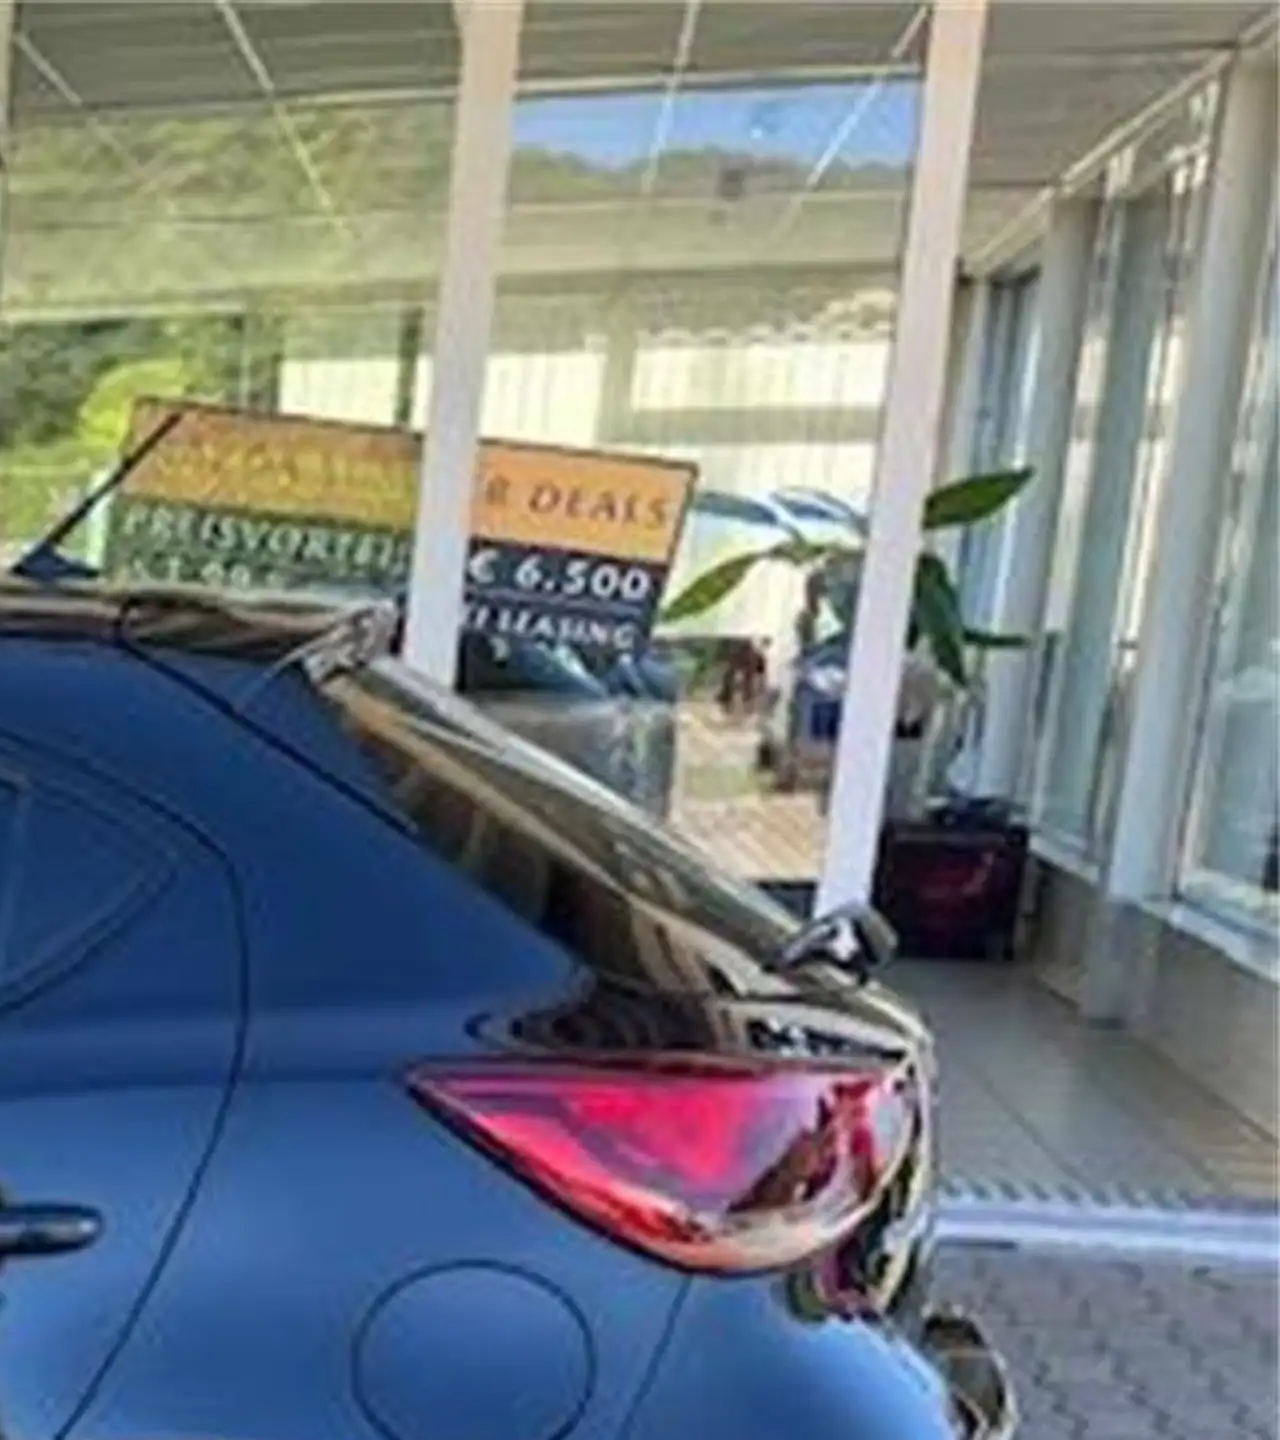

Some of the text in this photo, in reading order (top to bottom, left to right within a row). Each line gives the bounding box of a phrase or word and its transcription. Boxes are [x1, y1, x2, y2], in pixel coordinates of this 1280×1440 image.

[527, 480, 668, 531] DEALS
[513, 555, 652, 600] 6.500
[497, 606, 638, 650] LEASING
